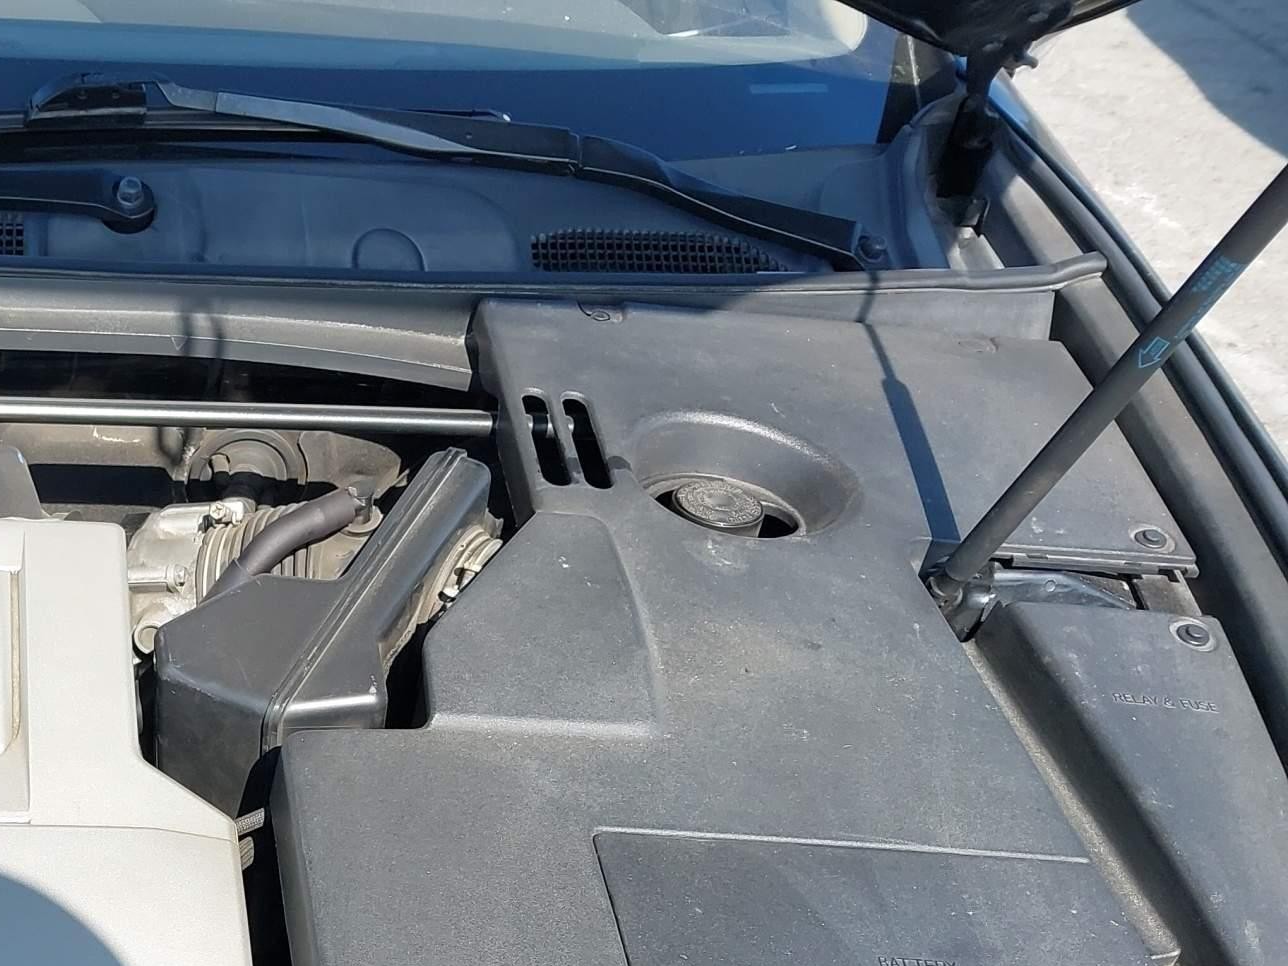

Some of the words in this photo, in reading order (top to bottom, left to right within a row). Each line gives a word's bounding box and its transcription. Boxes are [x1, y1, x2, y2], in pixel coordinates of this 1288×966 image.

[1112, 692, 1158, 705] RELAY
[1163, 696, 1175, 708] &
[1179, 698, 1218, 712] FUSE
